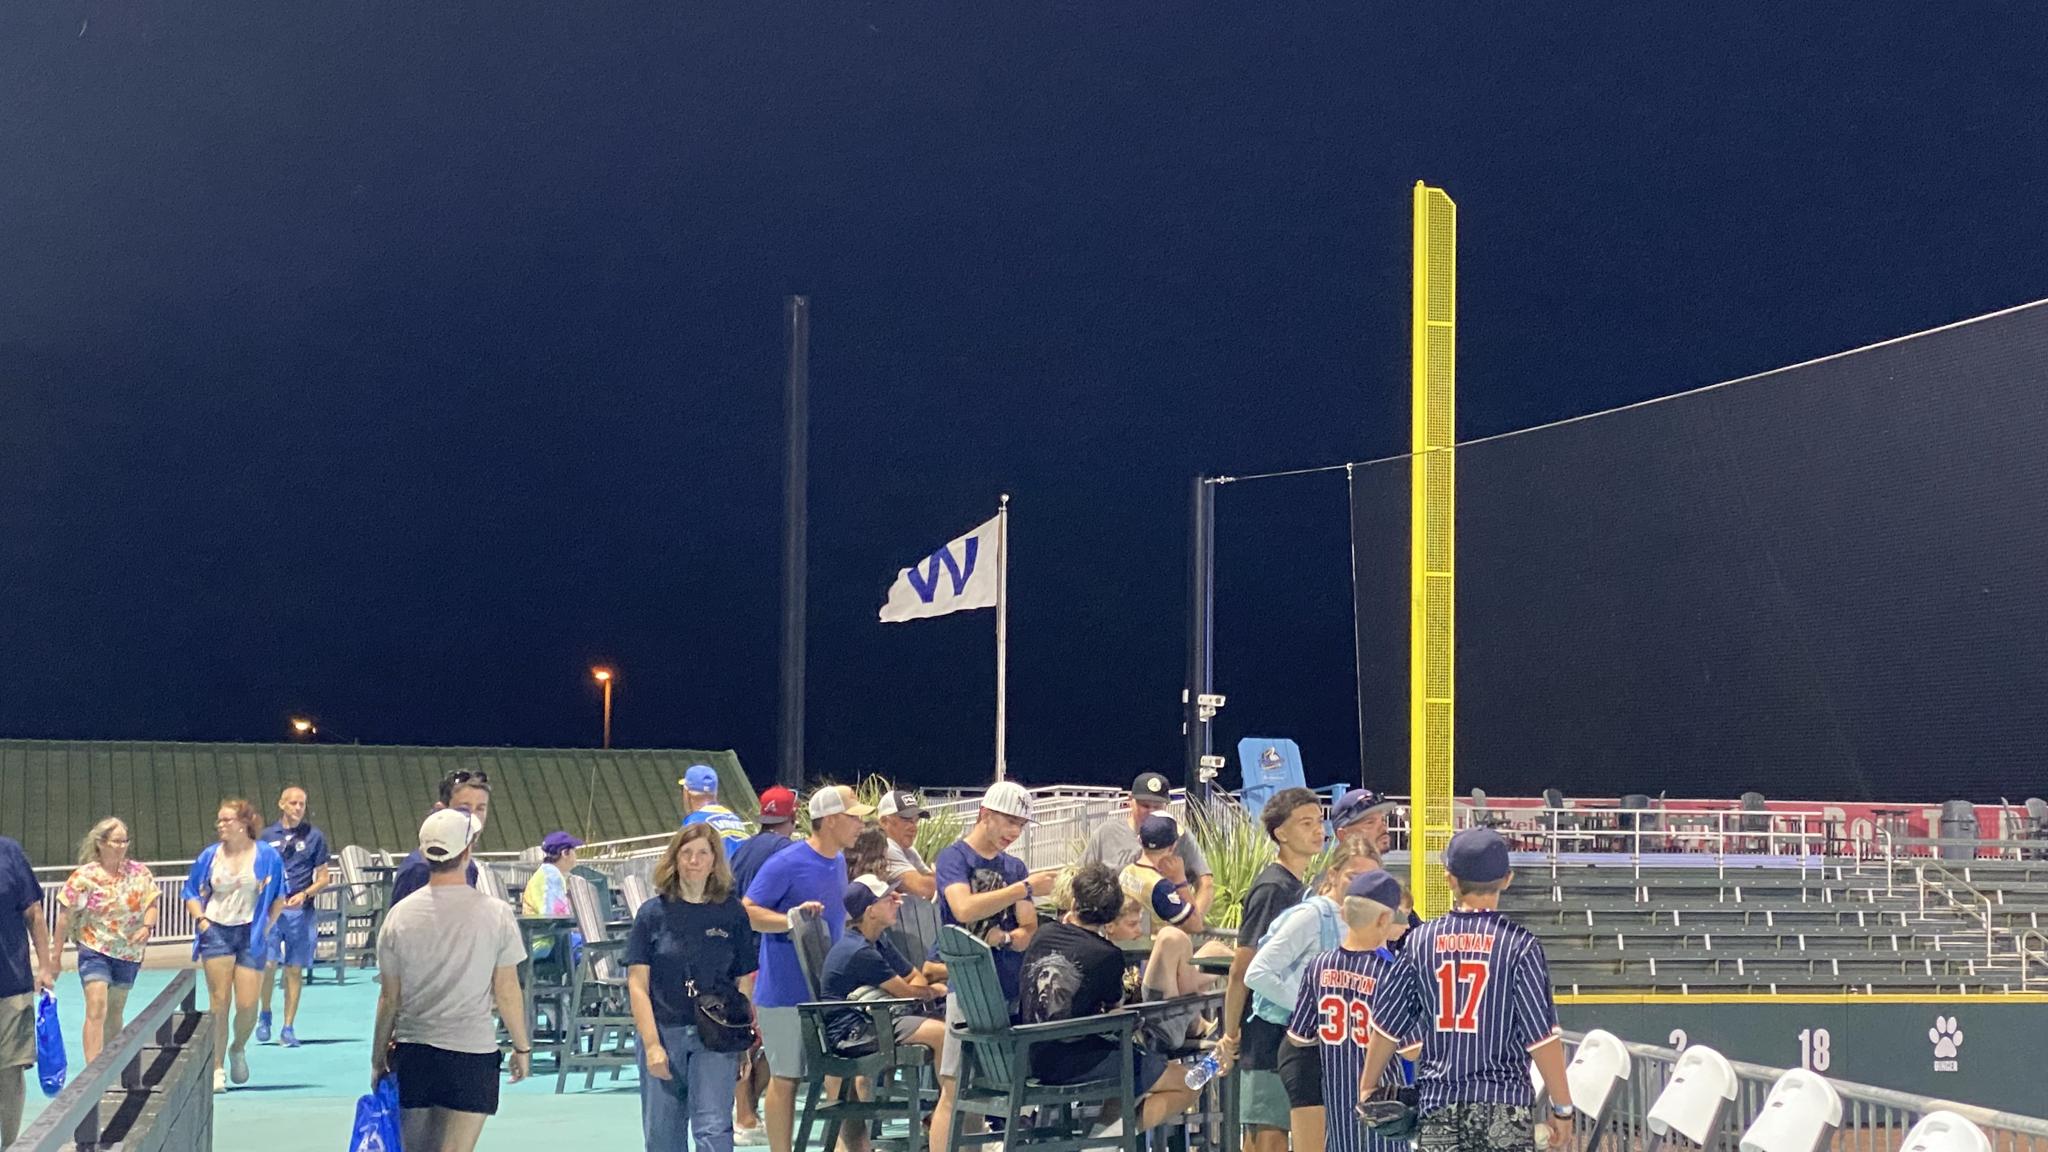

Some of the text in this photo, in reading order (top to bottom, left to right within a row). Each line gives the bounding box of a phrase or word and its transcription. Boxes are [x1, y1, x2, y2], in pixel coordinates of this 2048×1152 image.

[907, 536, 979, 604] W
[1317, 994, 1372, 1048] 33
[1435, 959, 1490, 1034] 17
[1798, 1028, 1831, 1072] 18
